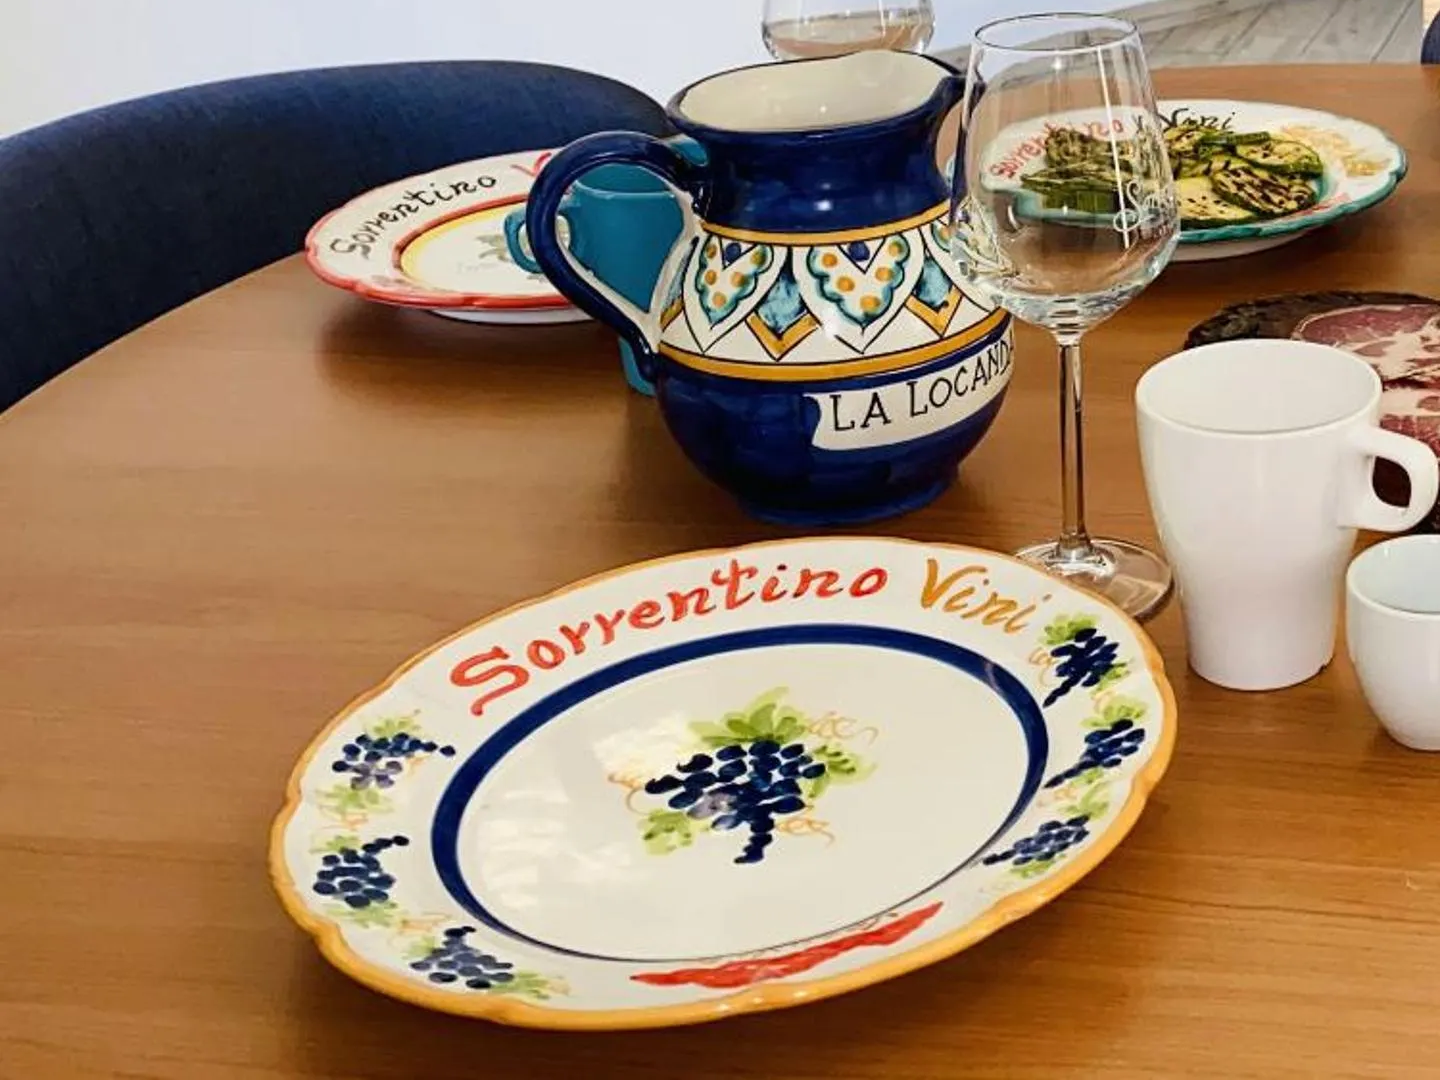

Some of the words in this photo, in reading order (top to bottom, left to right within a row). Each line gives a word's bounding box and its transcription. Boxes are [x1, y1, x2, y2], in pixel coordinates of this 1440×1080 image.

[330, 174, 497, 260] Sorrentino
[830, 392, 891, 431] LA
[449, 557, 889, 717] Sorrentino
[918, 558, 1054, 638] Vini
